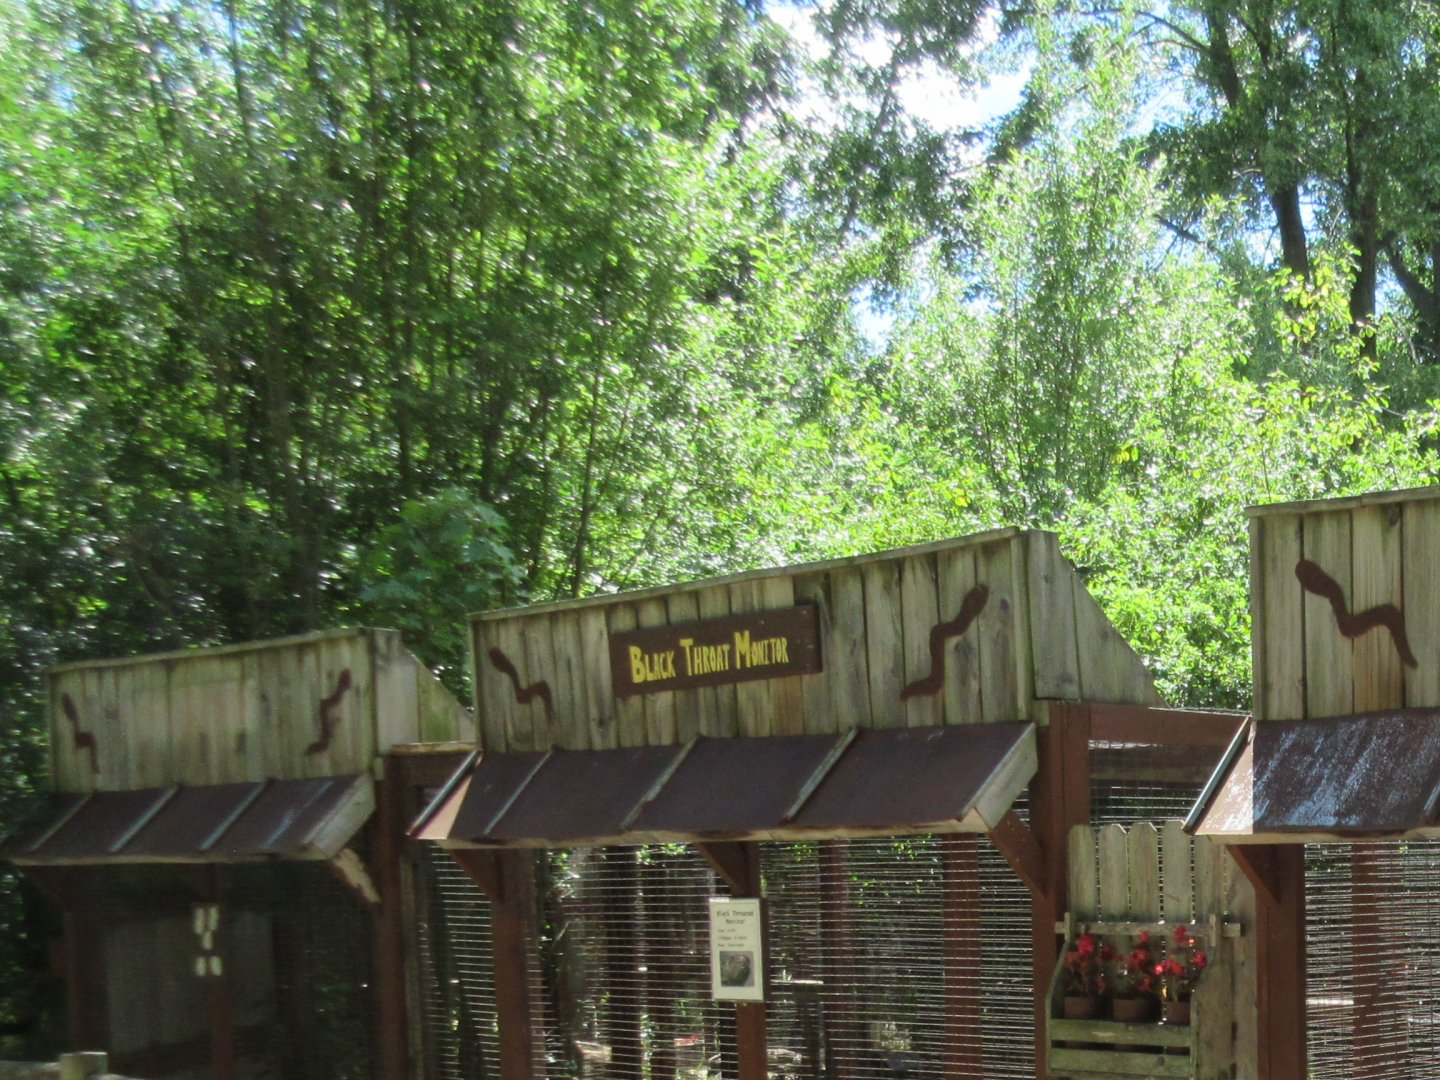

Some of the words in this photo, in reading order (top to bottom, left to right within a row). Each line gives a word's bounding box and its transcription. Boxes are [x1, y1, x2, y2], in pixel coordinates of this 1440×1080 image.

[629, 645, 677, 684] BLACK
[679, 638, 731, 677] THROAT
[734, 630, 789, 670] MONITOR
